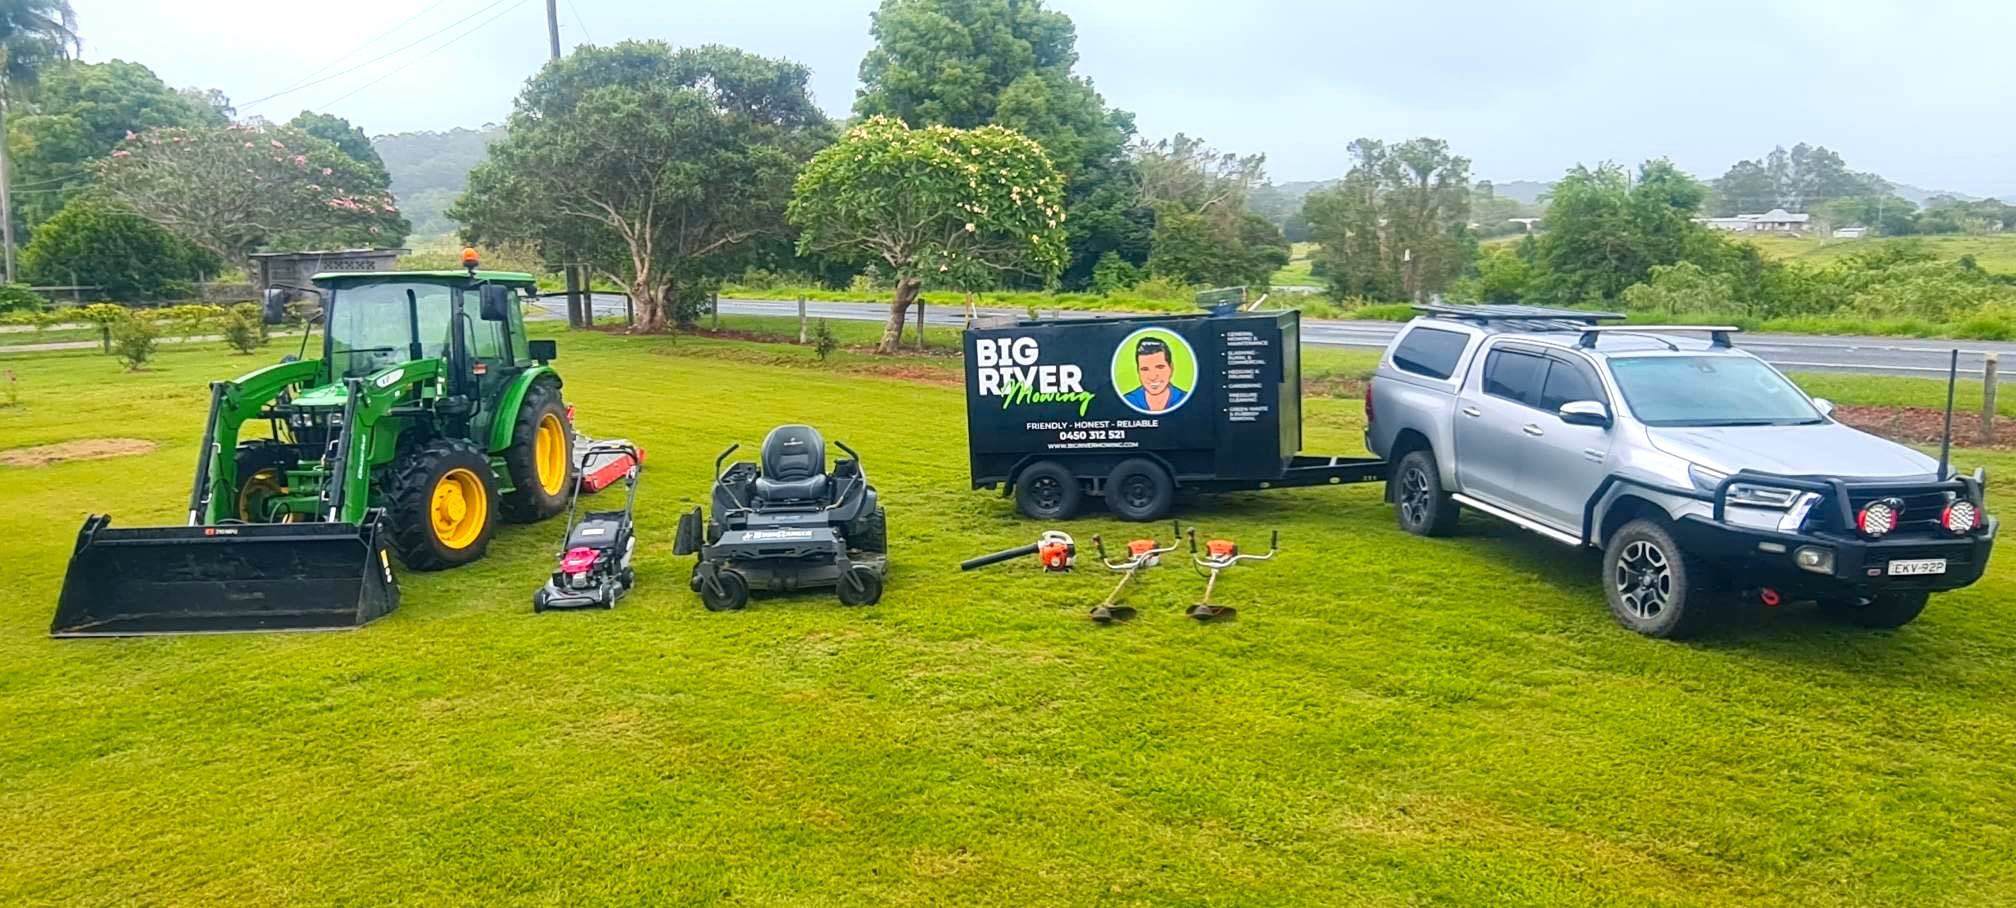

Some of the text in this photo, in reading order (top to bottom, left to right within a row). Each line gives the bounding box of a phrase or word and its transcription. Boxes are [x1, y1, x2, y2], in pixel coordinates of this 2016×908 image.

[976, 337, 1039, 367] BIG
[978, 364, 1084, 396] RIVER
[1000, 379, 1095, 416] Mowing
[1026, 422, 1068, 430] FRIENDLY
[1074, 420, 1110, 429] HONEST
[1116, 419, 1159, 428] RELIABLE
[1059, 430, 1125, 440] 0450 312 521
